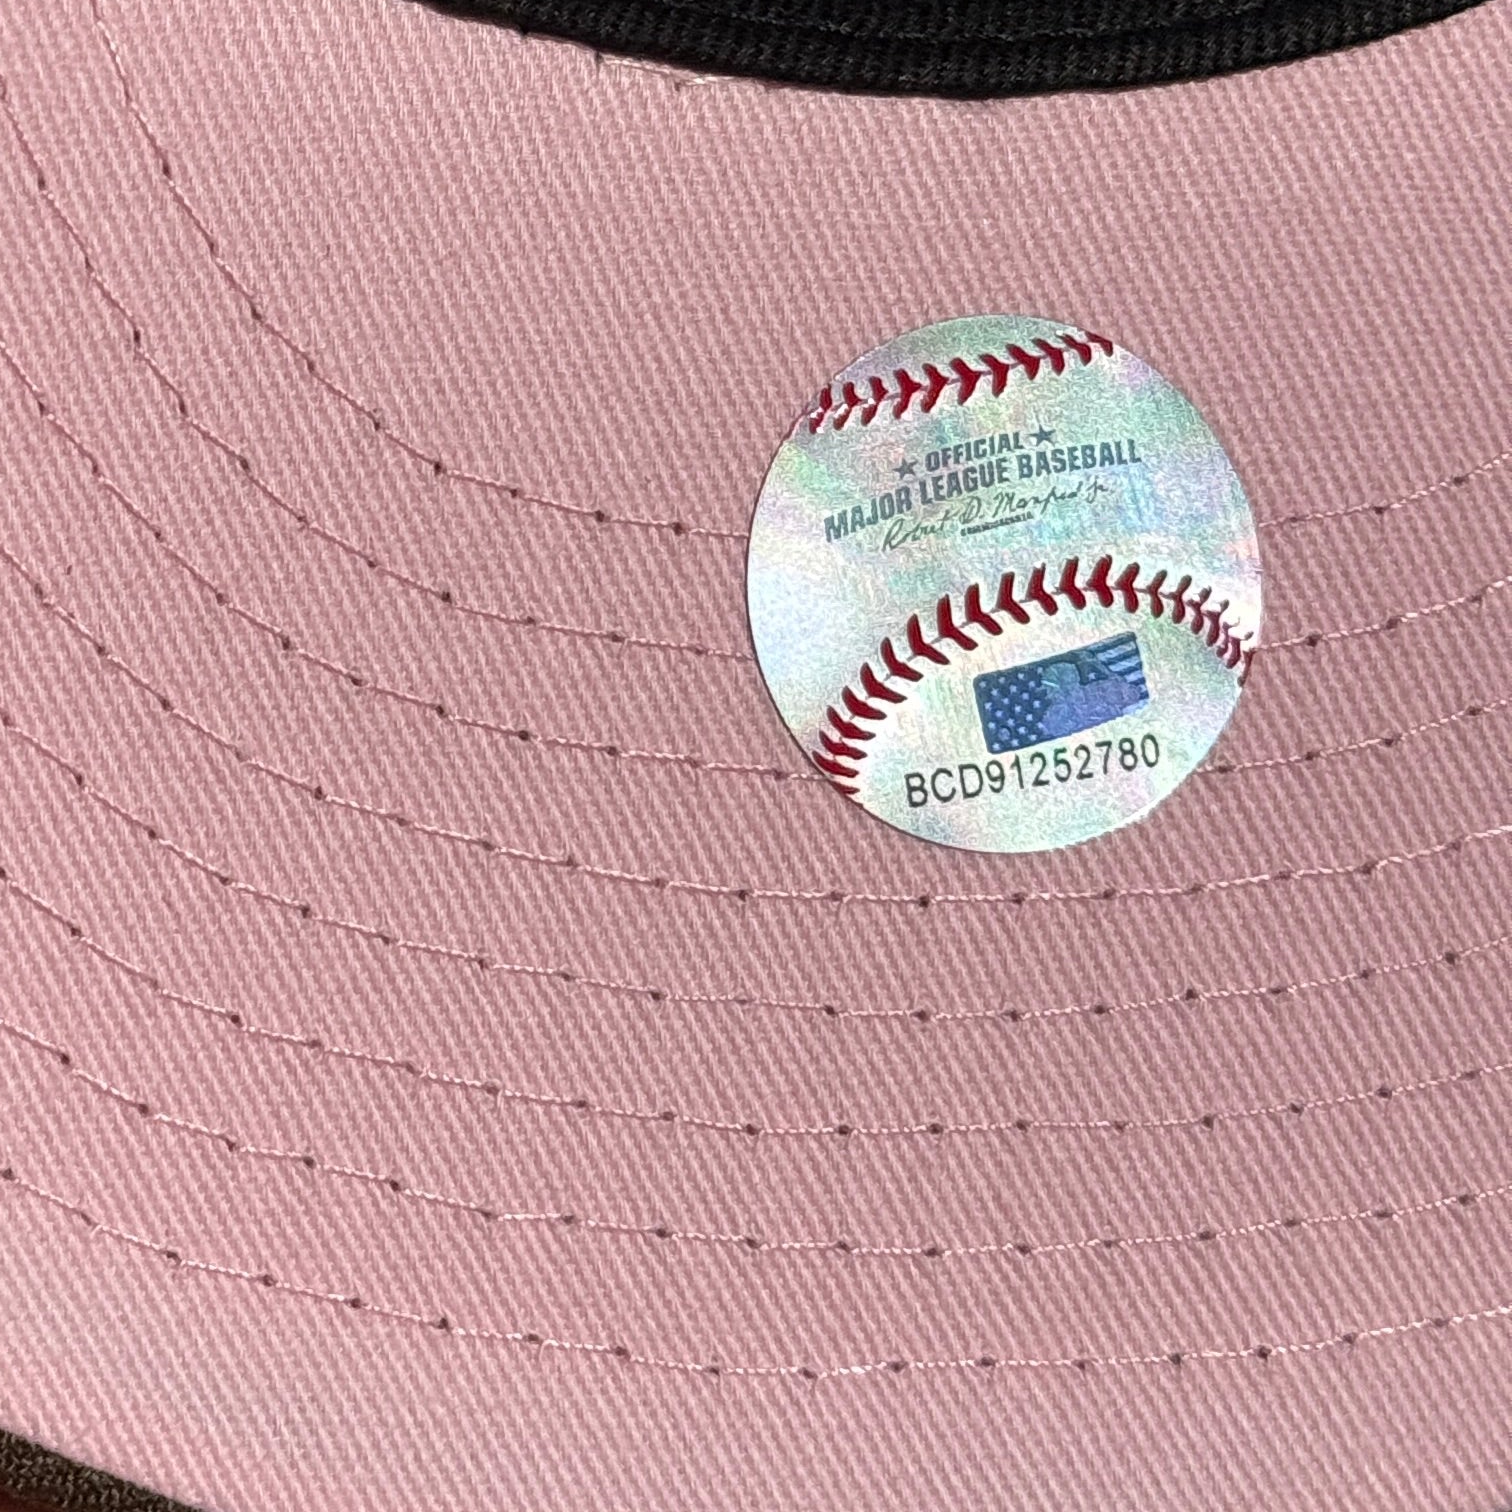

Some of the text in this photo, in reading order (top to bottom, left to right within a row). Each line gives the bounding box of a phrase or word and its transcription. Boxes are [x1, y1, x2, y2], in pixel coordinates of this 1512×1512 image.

[924, 431, 1025, 472] OFFICIAL
[823, 485, 914, 543] MAJOR
[919, 455, 1012, 505] LEAGUE
[1016, 438, 1143, 480] BASEBALL
[903, 732, 1161, 809] BCD91252780
